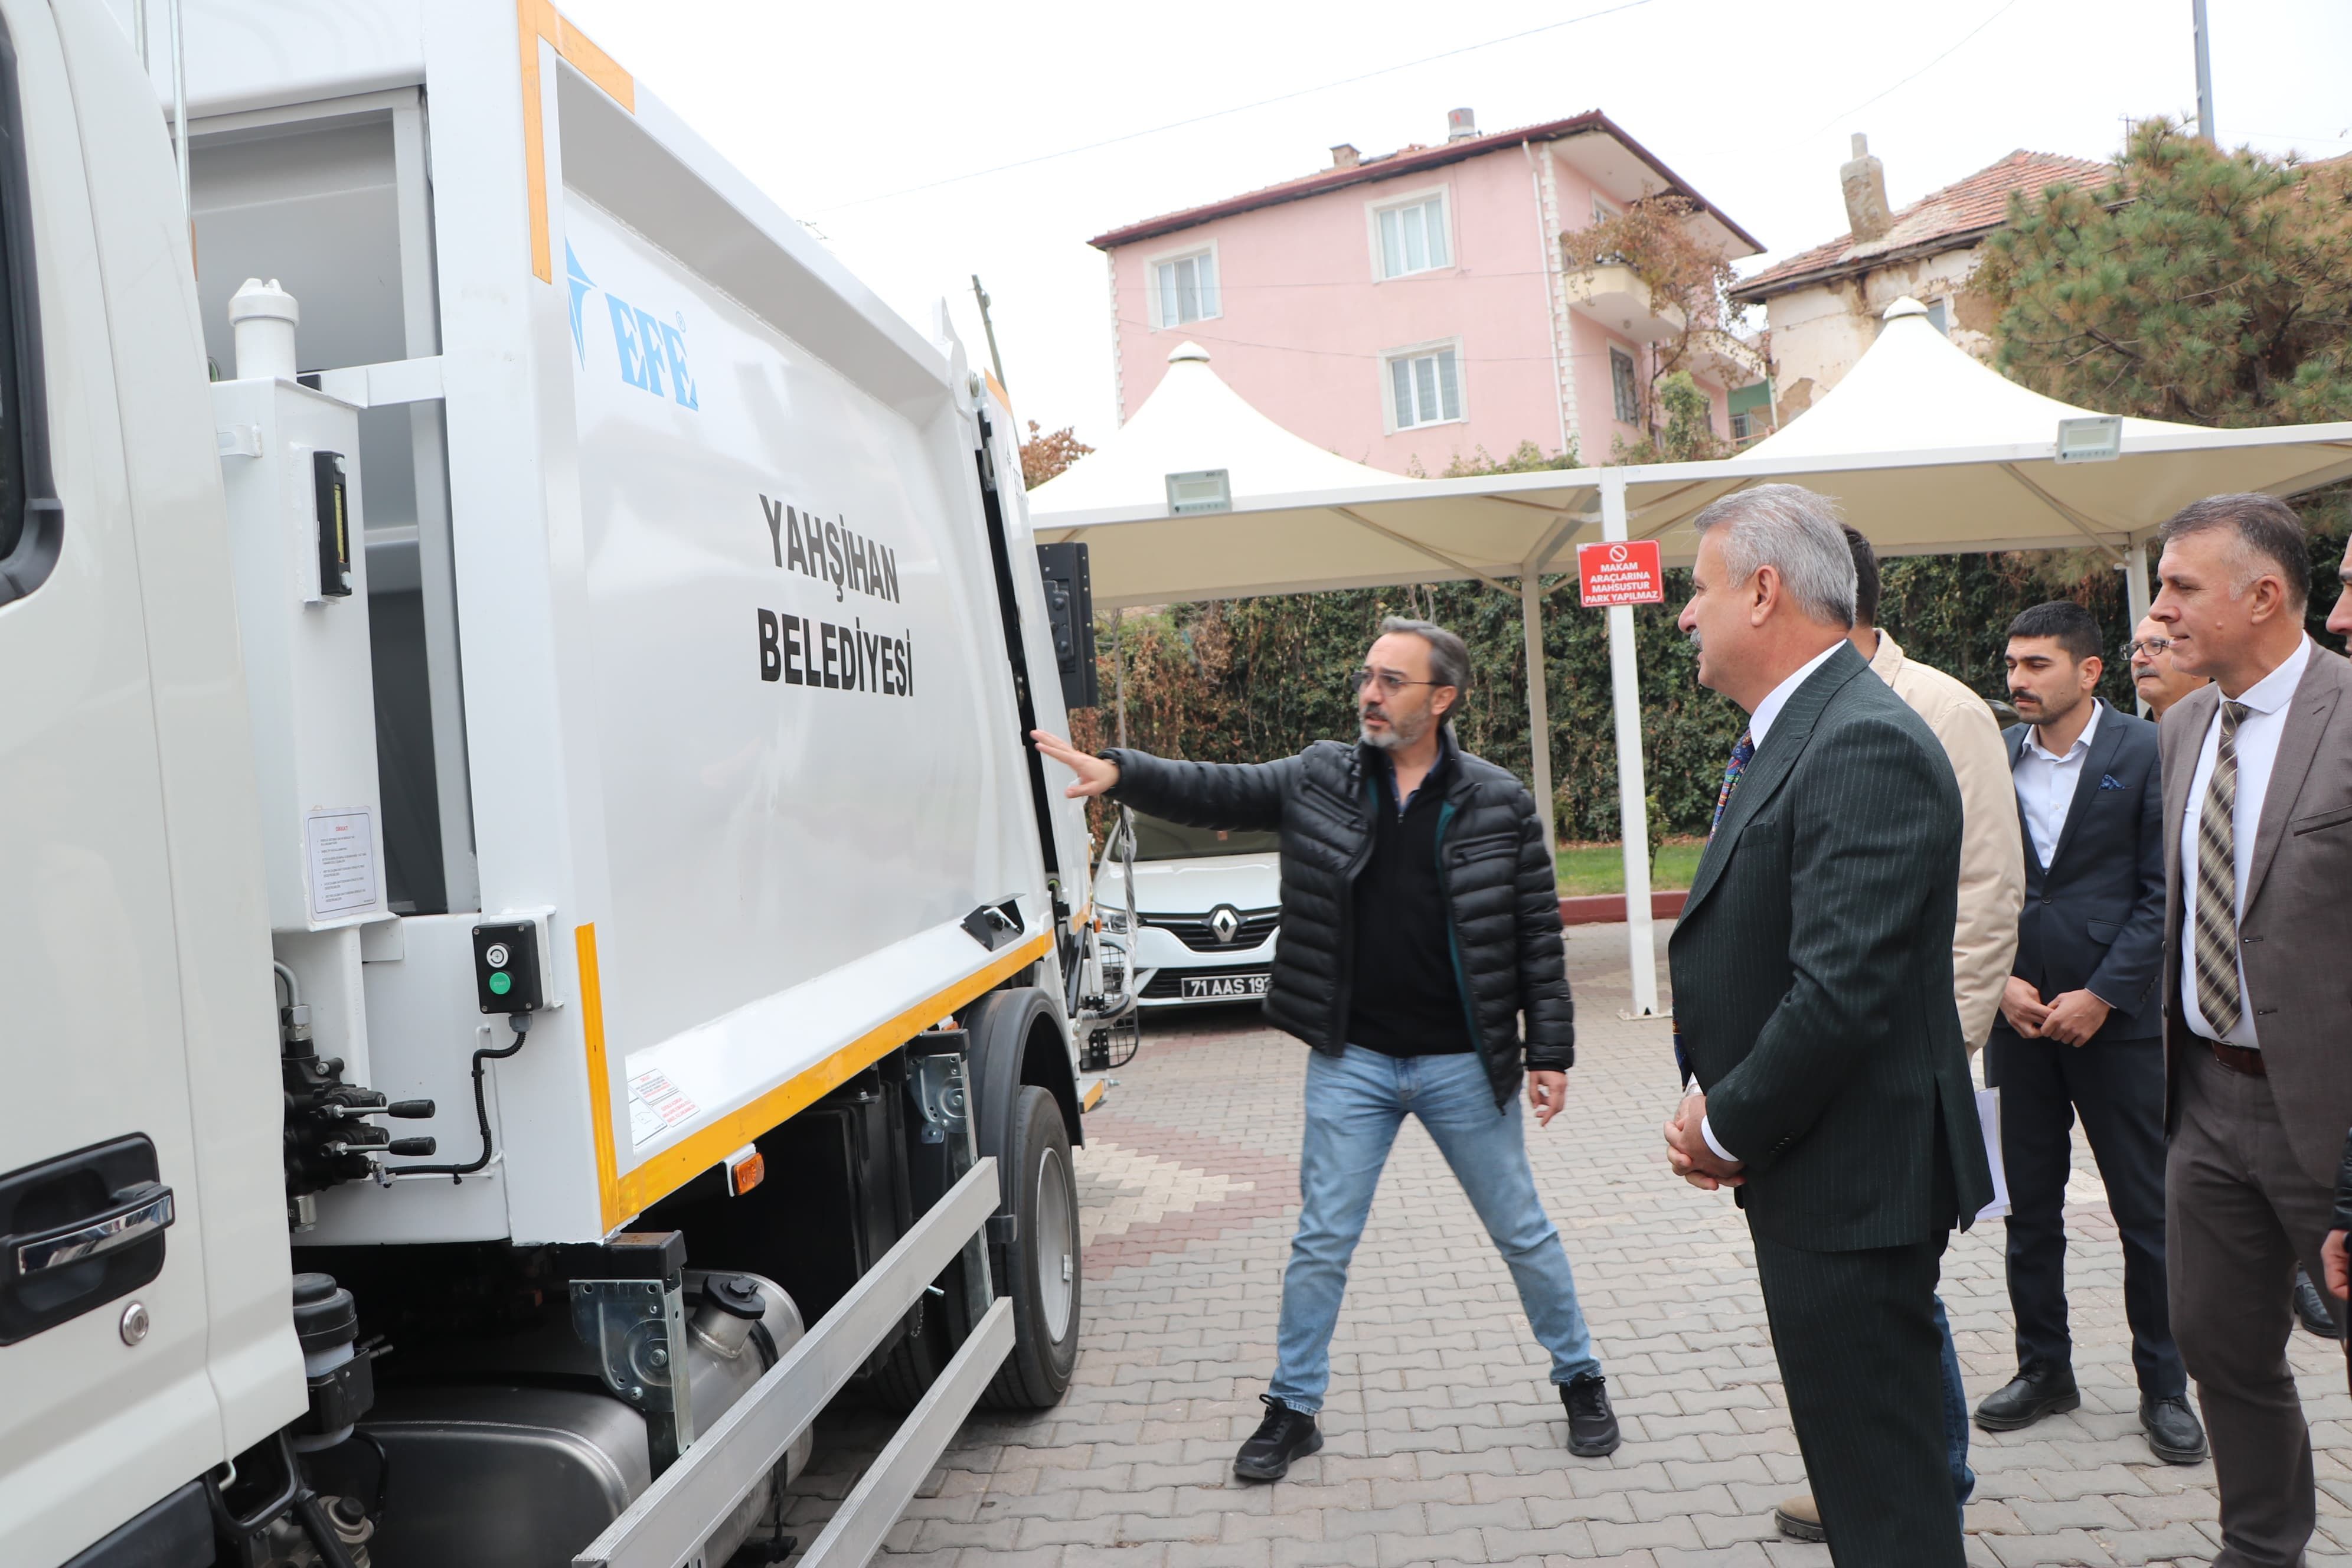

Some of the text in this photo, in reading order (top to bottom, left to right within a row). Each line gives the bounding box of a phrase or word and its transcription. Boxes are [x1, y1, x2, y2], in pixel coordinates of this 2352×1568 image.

[605, 292, 698, 411] EFE
[759, 493, 900, 604] YAHŞİHAN
[1600, 562, 1638, 571] MAKAM
[1590, 571, 1651, 583] ARAÇLARINA
[1592, 582, 1649, 593] MAHSUSTUR
[1611, 591, 1658, 601] YAPILMAZ
[757, 607, 913, 697] BELEDİYESİ
[1190, 980, 1208, 997] 71
[1211, 978, 1245, 995] AAS
